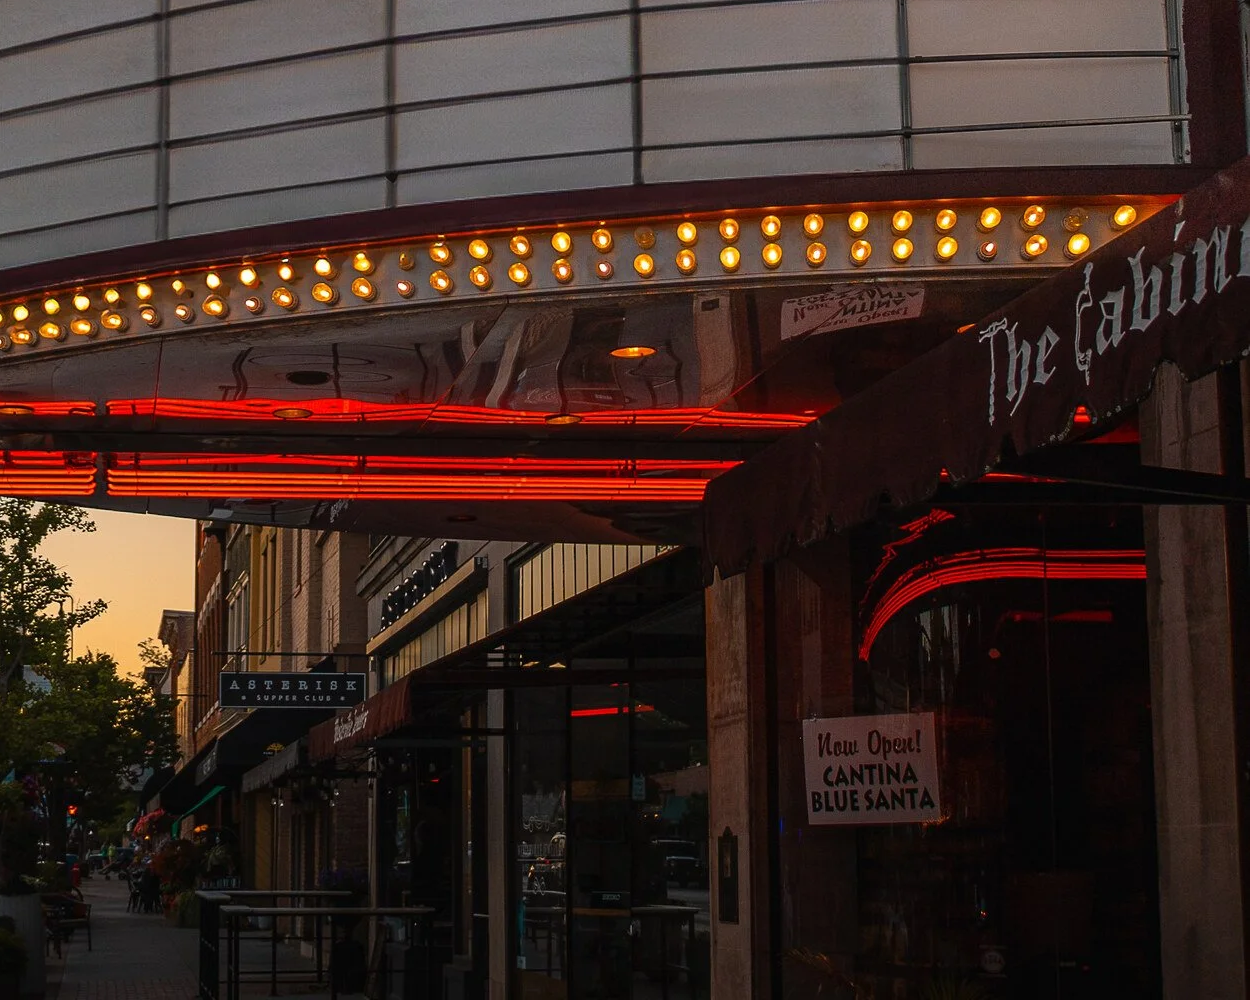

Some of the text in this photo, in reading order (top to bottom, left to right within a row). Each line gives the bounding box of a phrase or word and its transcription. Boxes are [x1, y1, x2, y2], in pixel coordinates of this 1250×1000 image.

[979, 317, 1060, 426] The
[229, 680, 357, 691] ASTERISK
[256, 694, 332, 702] SUPPER CLUB
[818, 729, 922, 761] Now Open!
[822, 761, 919, 787] CANTINA
[811, 787, 936, 813] BLUE SANTA
